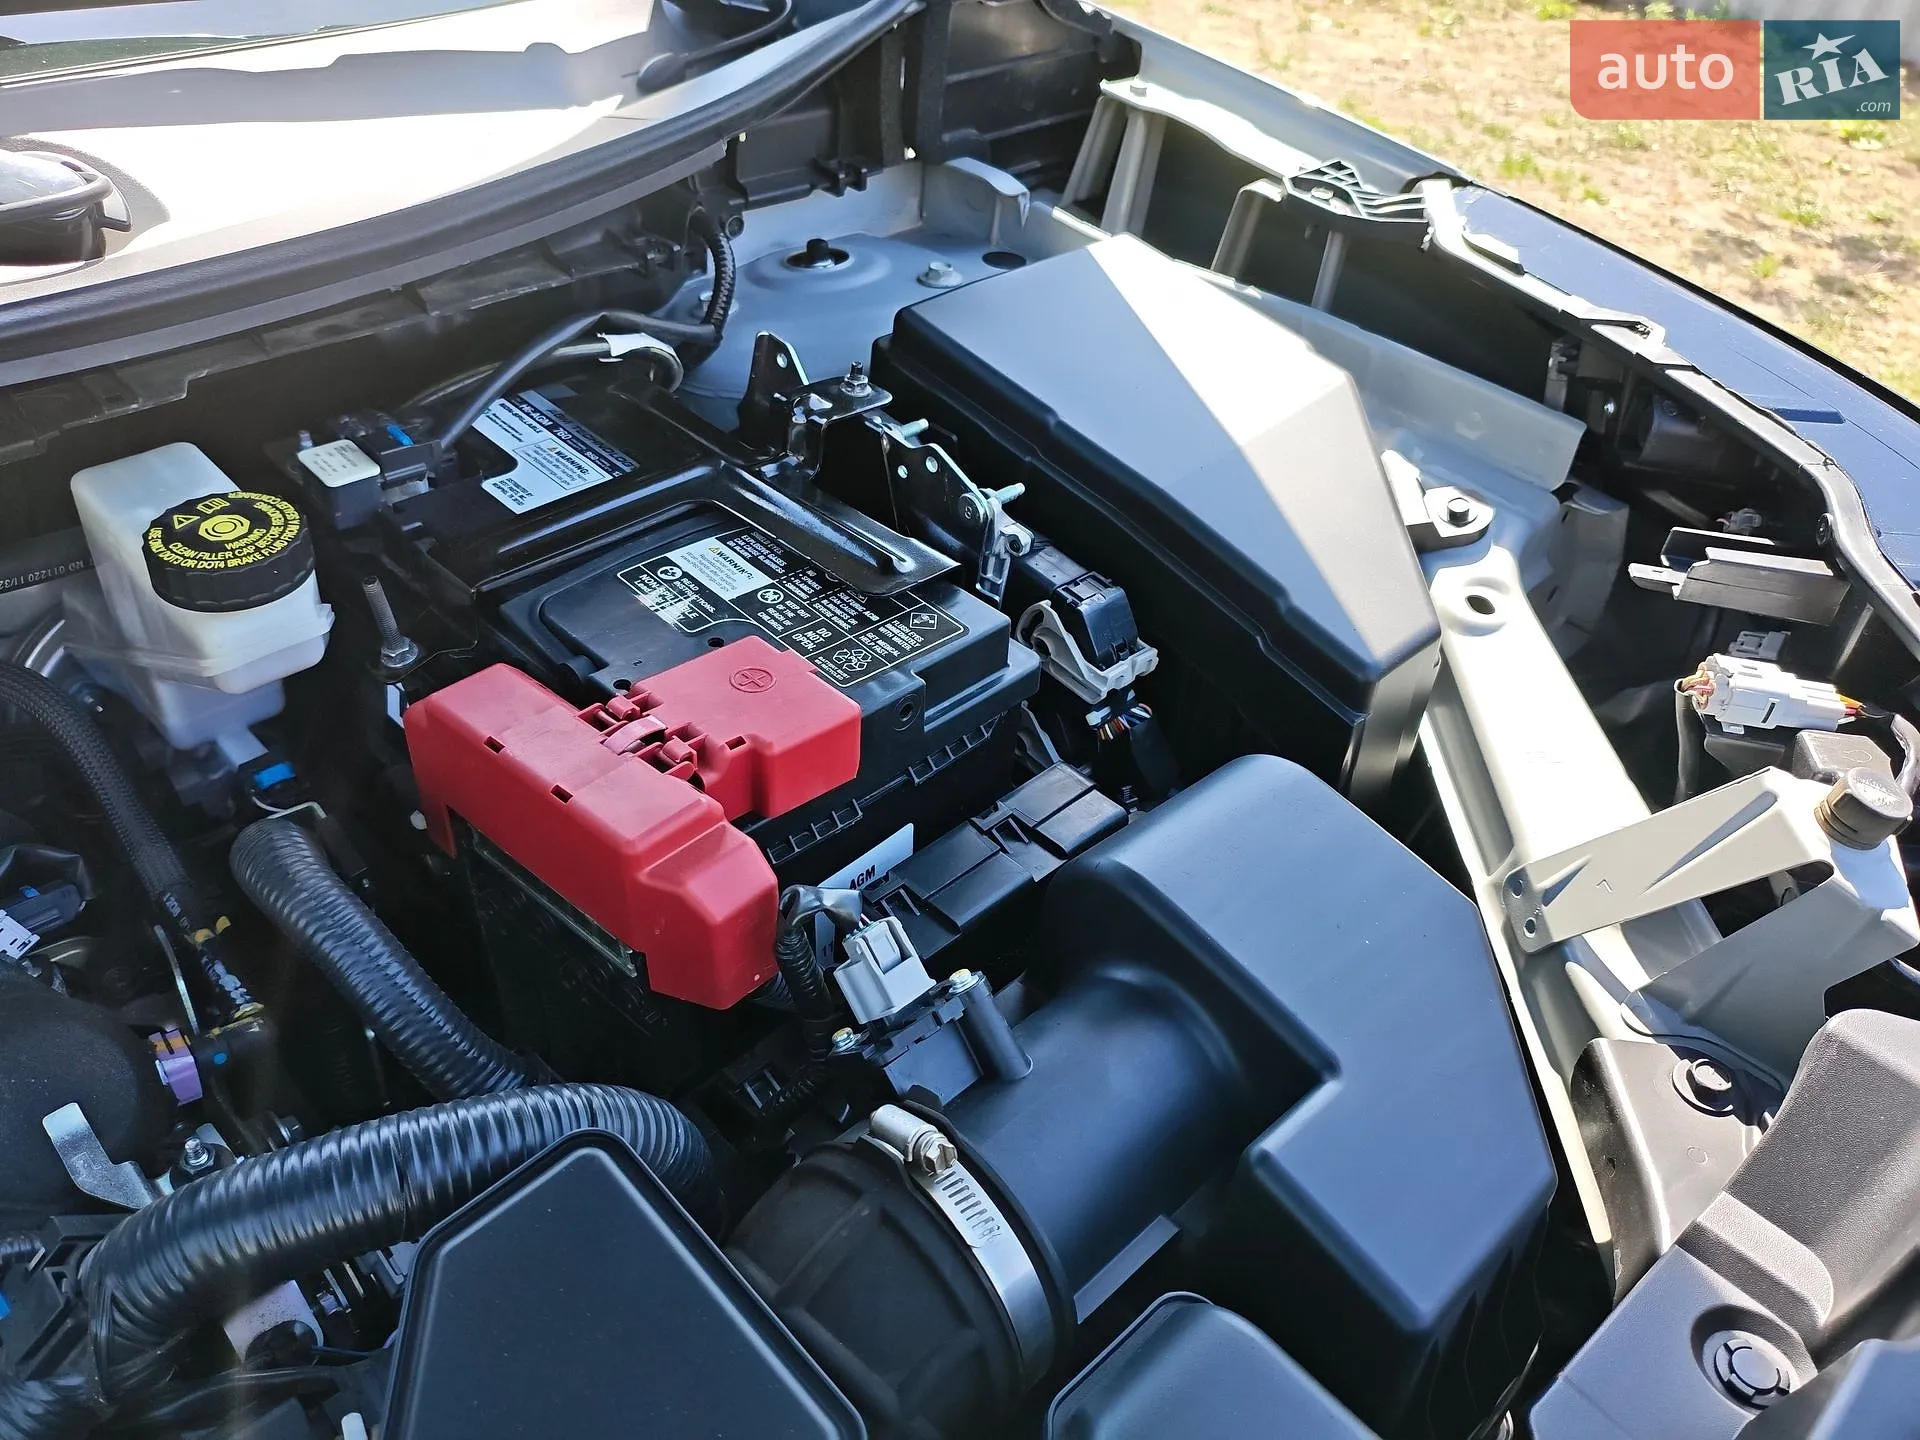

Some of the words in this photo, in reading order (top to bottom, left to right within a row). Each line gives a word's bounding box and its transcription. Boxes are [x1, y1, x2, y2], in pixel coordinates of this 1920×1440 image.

[553, 428, 572, 440] 760
[555, 451, 589, 474] WARNING:
[148, 528, 163, 540] USE
[159, 551, 184, 565] DOT3
[181, 559, 198, 569] OR
[197, 560, 225, 569] DOT4
[227, 552, 265, 567] BRAKE
[261, 539, 288, 556] FLUID
[169, 542, 199, 558] CLEAN
[196, 551, 234, 560] FILLER
[235, 545, 256, 557] CAP
[255, 526, 284, 548] BEFORE
[225, 529, 266, 550] WARNING
[734, 538, 746, 546] CAN
[743, 545, 761, 556] CAUSE
[741, 535, 770, 555] EXPLOSIVE
[767, 554, 787, 566] GASES
[29, 565, 65, 582] 011220
[634, 580, 653, 593] Lead
[681, 578, 699, 591] READ
[785, 583, 809, 599] SMOKING
[793, 579, 814, 594] FLAMES
[801, 576, 822, 590] SPARKS
[639, 574, 699, 619] NON-SPILLBLE
[766, 608, 786, 621] REACH
[783, 609, 796, 618] THE
[785, 600, 800, 610] KEEP
[797, 609, 811, 618] OUT
[813, 603, 834, 617] SEVERE
[821, 599, 850, 619] BLINDNESS
[829, 596, 841, 604] CAN
[840, 604, 858, 616] CAUSE
[837, 592, 866, 612] SULFURIC
[863, 611, 880, 621] ACID
[816, 628, 832, 638] DO
[885, 623, 920, 647] IMMEDIATELY
[892, 620, 911, 633] FLUSH
[792, 633, 816, 651] OPEN.
[804, 631, 825, 643] NOT
[859, 635, 875, 646] HELP
[872, 645, 888, 656] FAST.
[866, 632, 879, 641] GET
[876, 640, 900, 656] MEDICAL
[878, 626, 894, 637] WITH
[892, 636, 912, 651] WATER.
[849, 865, 876, 890] AGM
